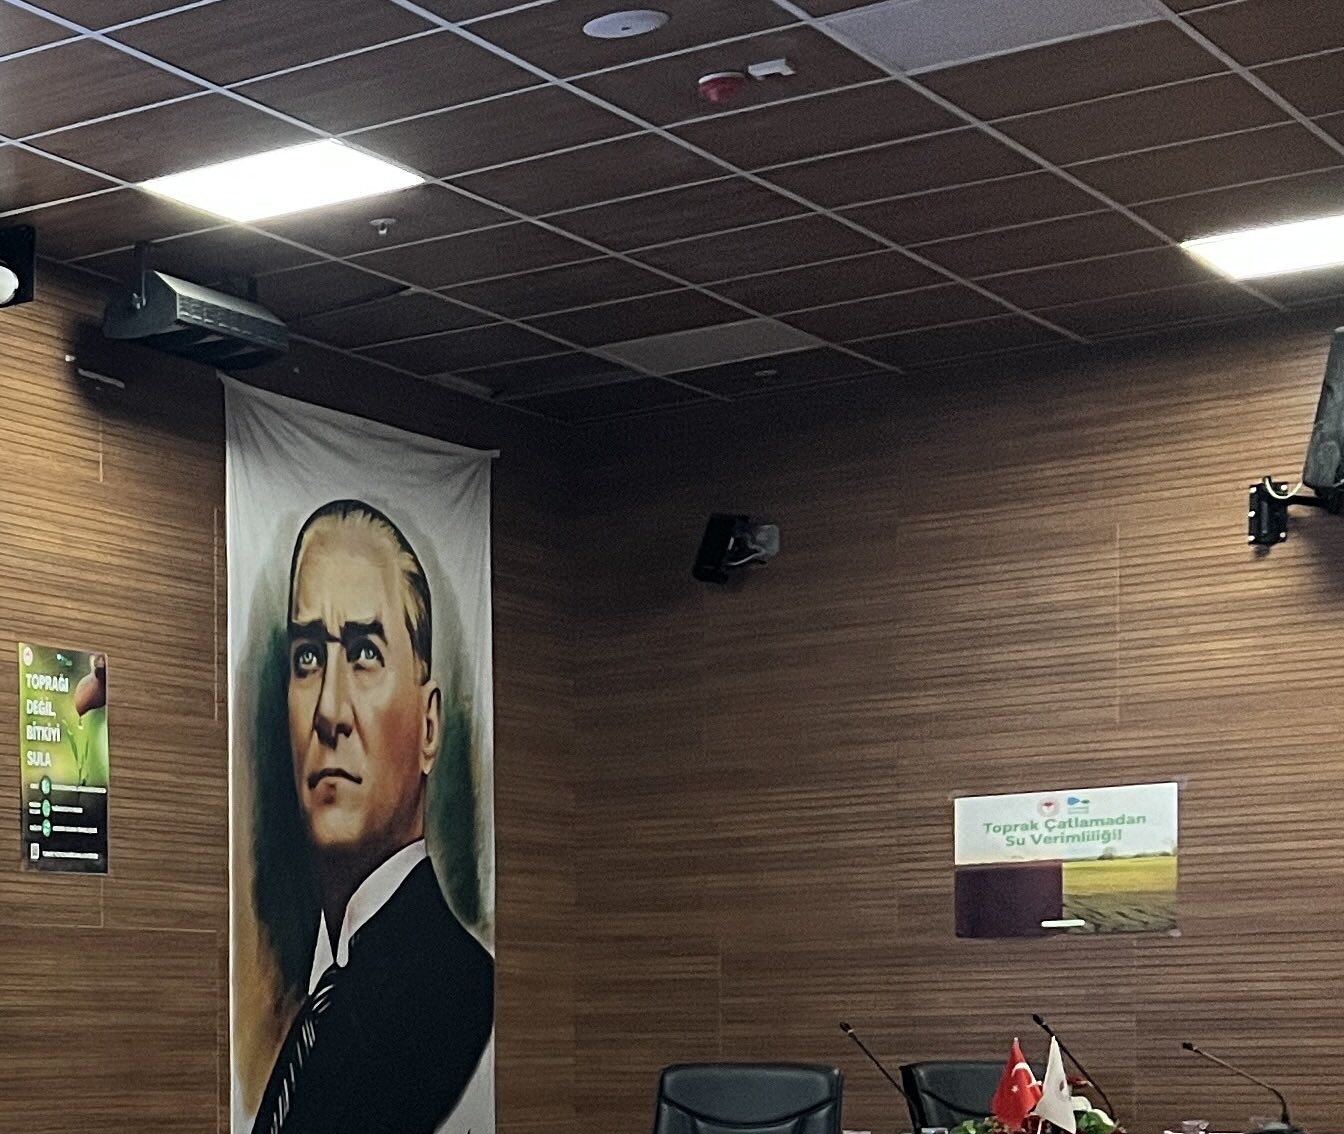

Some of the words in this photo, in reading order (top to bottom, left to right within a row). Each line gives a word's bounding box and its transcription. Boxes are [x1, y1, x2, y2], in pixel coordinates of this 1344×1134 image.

[26, 673, 69, 693] TOPRAĞI
[27, 750, 51, 767] SULA
[983, 820, 1039, 835] Toprak
[1044, 813, 1147, 832] Çatlamadan
[1005, 834, 1026, 847] Su
